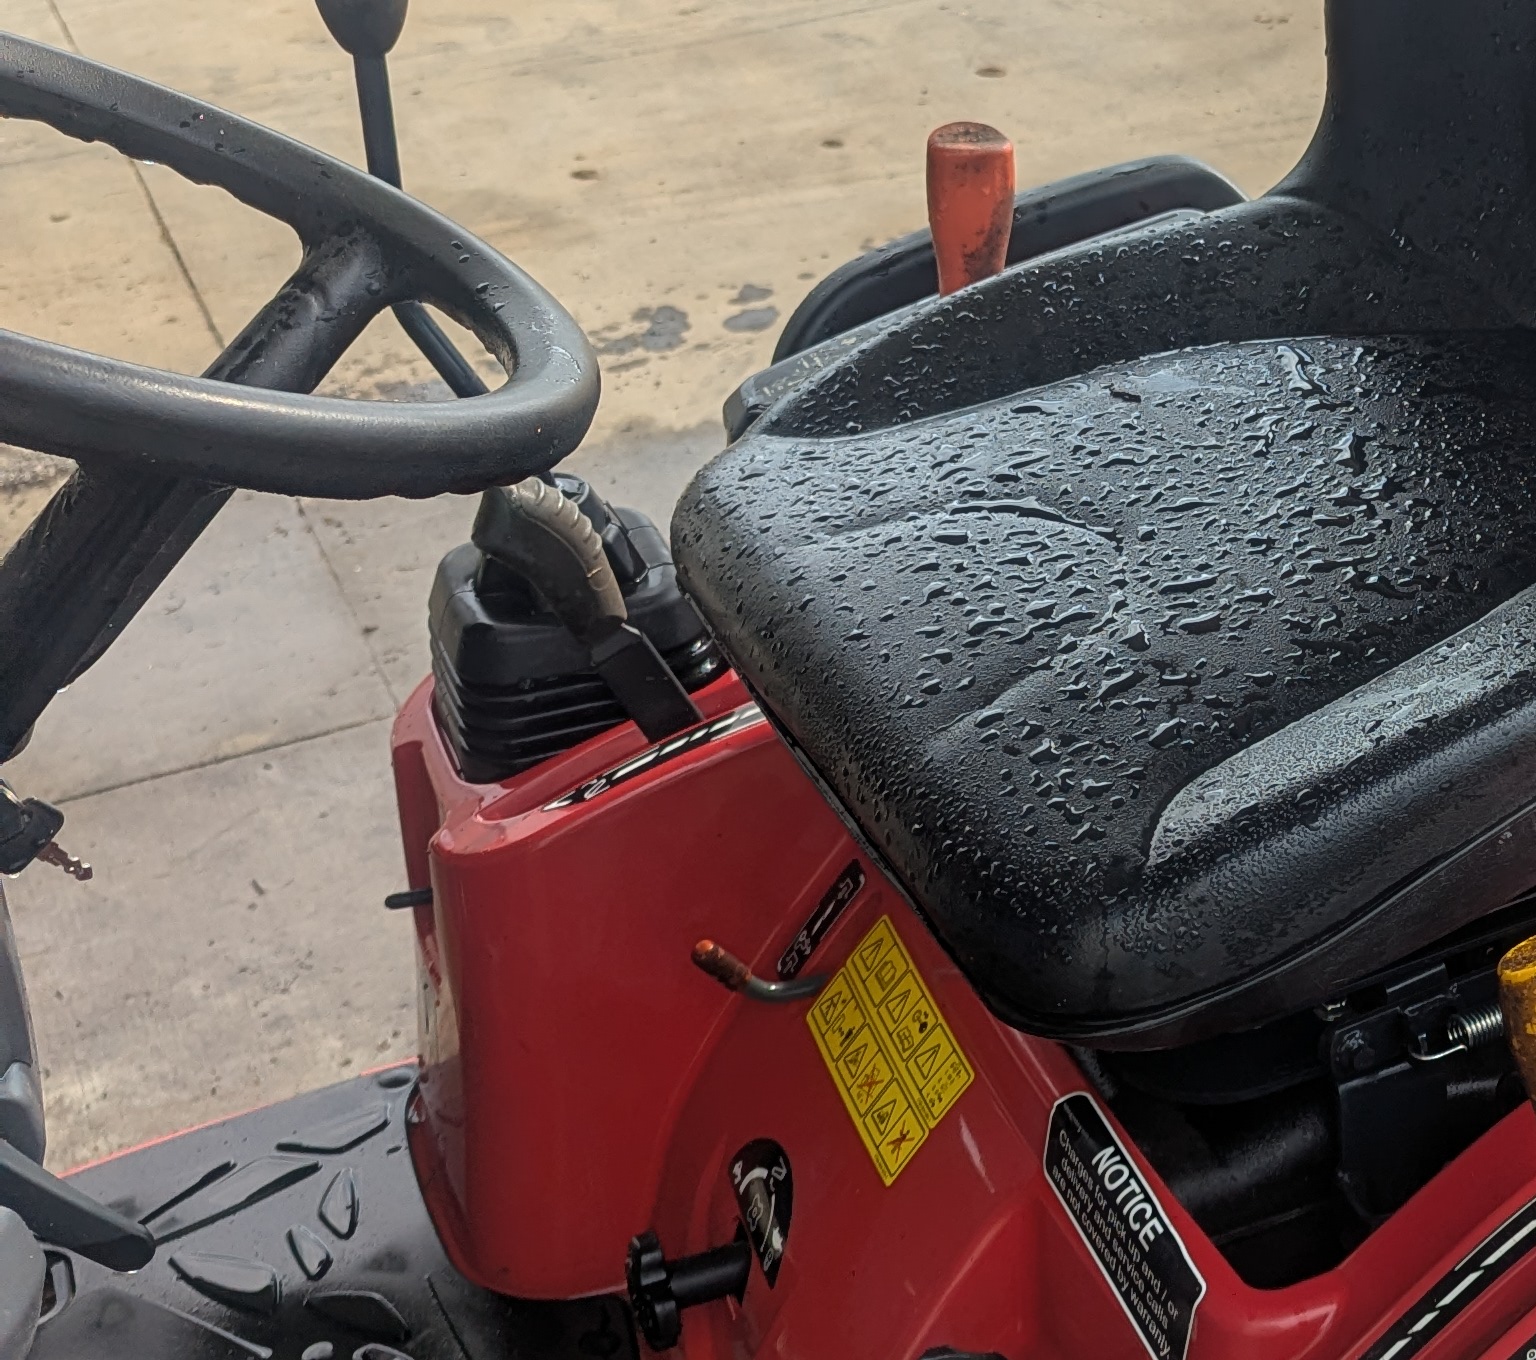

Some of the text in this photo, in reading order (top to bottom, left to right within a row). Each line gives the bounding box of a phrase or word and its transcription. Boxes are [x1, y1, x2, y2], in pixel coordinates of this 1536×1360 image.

[1052, 1164, 1066, 1191] are
[1067, 1188, 1080, 1215] not
[1081, 1210, 1116, 1271] covered
[1117, 1265, 1129, 1294] by
[1059, 1128, 1093, 1192] Charges
[1094, 1183, 1107, 1211] for
[1107, 1206, 1126, 1243] pick
[1128, 1238, 1140, 1264] up
[1141, 1259, 1160, 1295] and
[1167, 1299, 1178, 1321] or
[1061, 1156, 1093, 1214] delivery
[1094, 1208, 1111, 1241] and
[1112, 1237, 1144, 1293] service
[1146, 1290, 1168, 1330] calls
[1092, 1145, 1164, 1253] NOTICE
